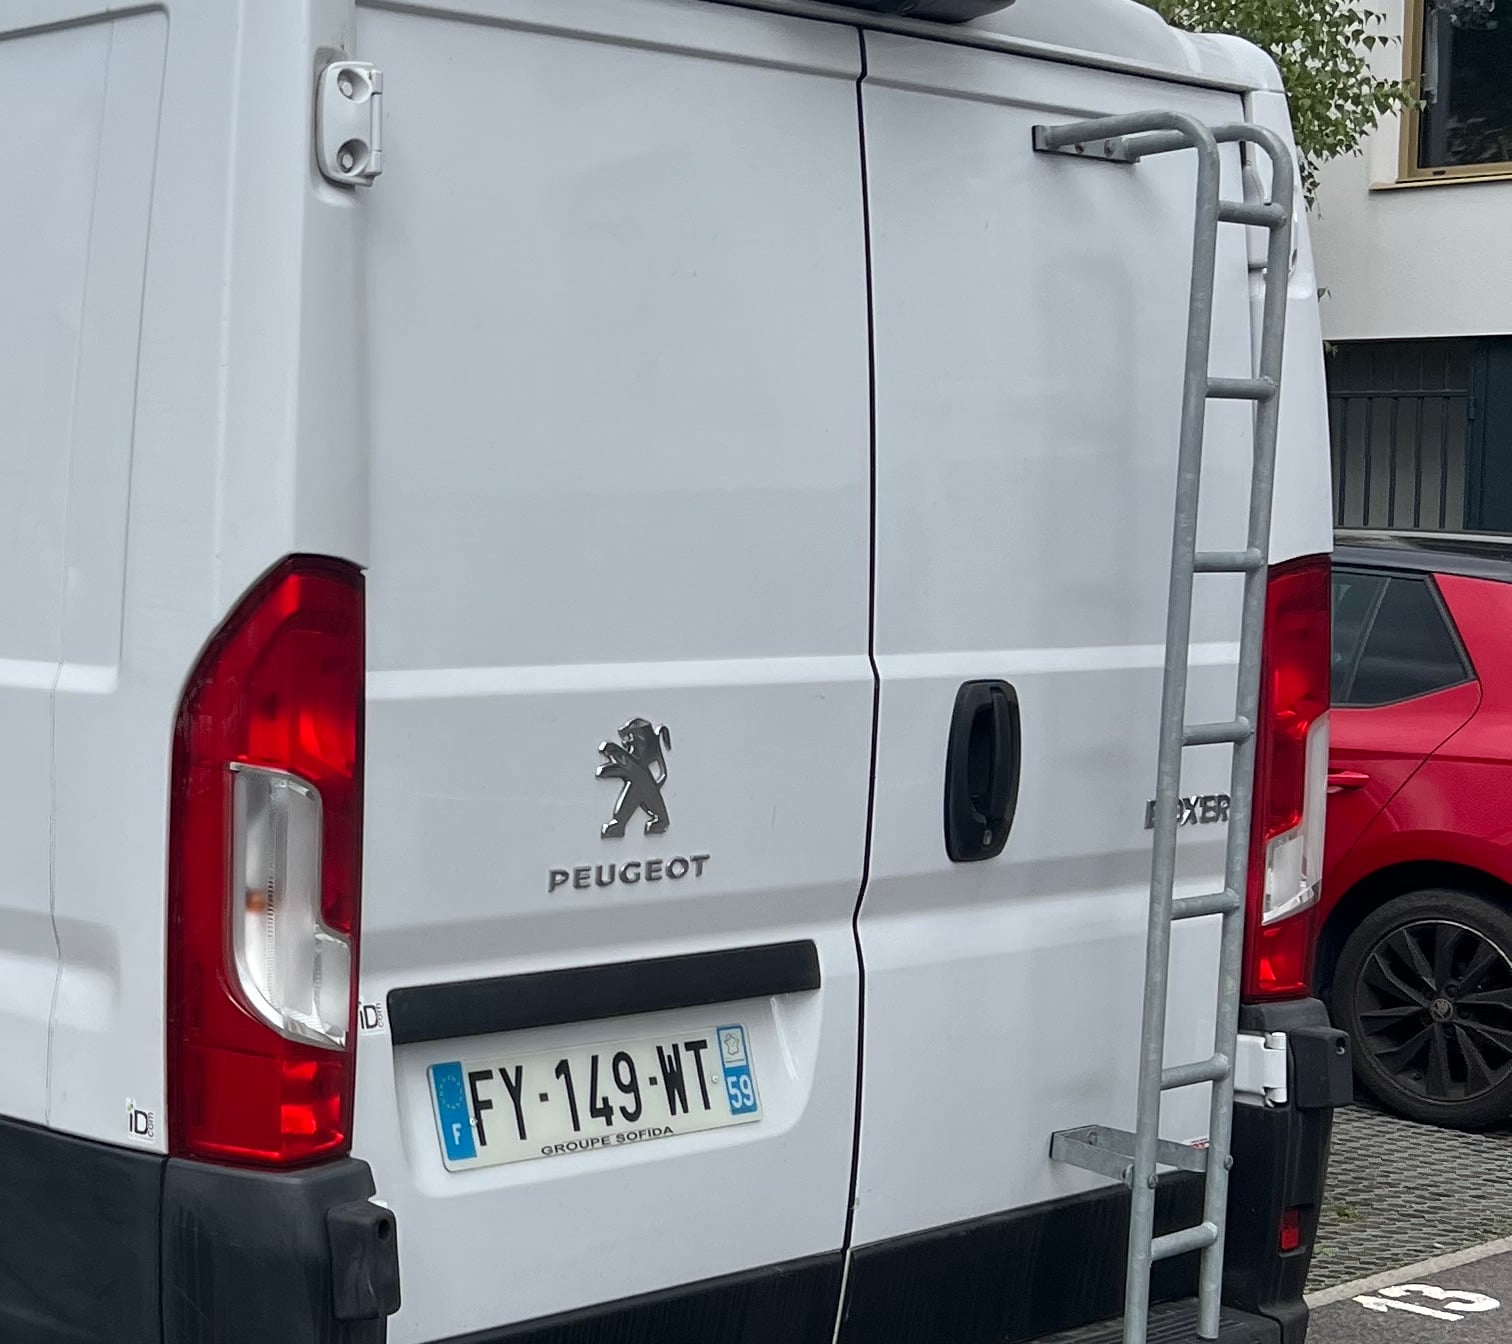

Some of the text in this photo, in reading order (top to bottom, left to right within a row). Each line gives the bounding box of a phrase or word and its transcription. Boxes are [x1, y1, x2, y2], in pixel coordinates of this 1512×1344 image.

[548, 854, 710, 893] PEUGEOT
[468, 1039, 711, 1146] FY-149-WT
[726, 1074, 755, 1109] 59
[451, 1122, 463, 1146] F
[540, 1125, 674, 1156] GROUPE SOFIDA
[1352, 1284, 1501, 1321] 13
